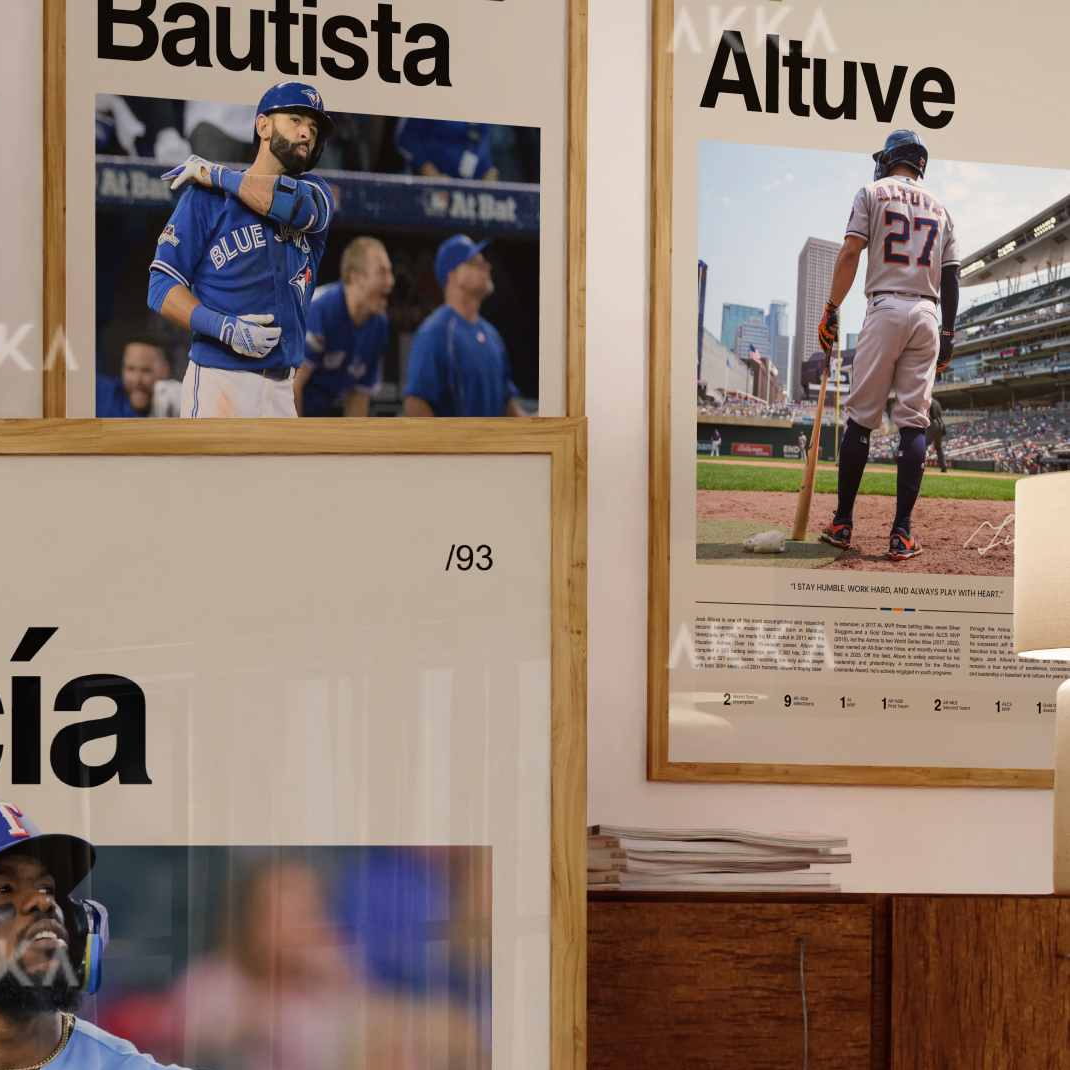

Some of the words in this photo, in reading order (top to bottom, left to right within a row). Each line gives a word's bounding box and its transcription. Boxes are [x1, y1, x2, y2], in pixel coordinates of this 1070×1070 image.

[98, 0, 452, 89] Bautista
[700, 31, 955, 129] Altuve
[876, 184, 943, 216] ALTUVE
[884, 210, 939, 268] 27
[210, 224, 266, 270] BLUE
[445, 545, 494, 571] /93
[798, 583, 815, 591] STAY
[817, 584, 846, 593] HUMBLE,
[848, 585, 869, 593] WORK
[871, 586, 892, 595] HARD,
[724, 693, 731, 705] 2
[784, 695, 791, 707] 9
[840, 697, 845, 708] 1
[881, 698, 886, 709] 1
[934, 699, 941, 711] 2
[995, 701, 1000, 712] 1
[1037, 702, 1041, 714] 1
